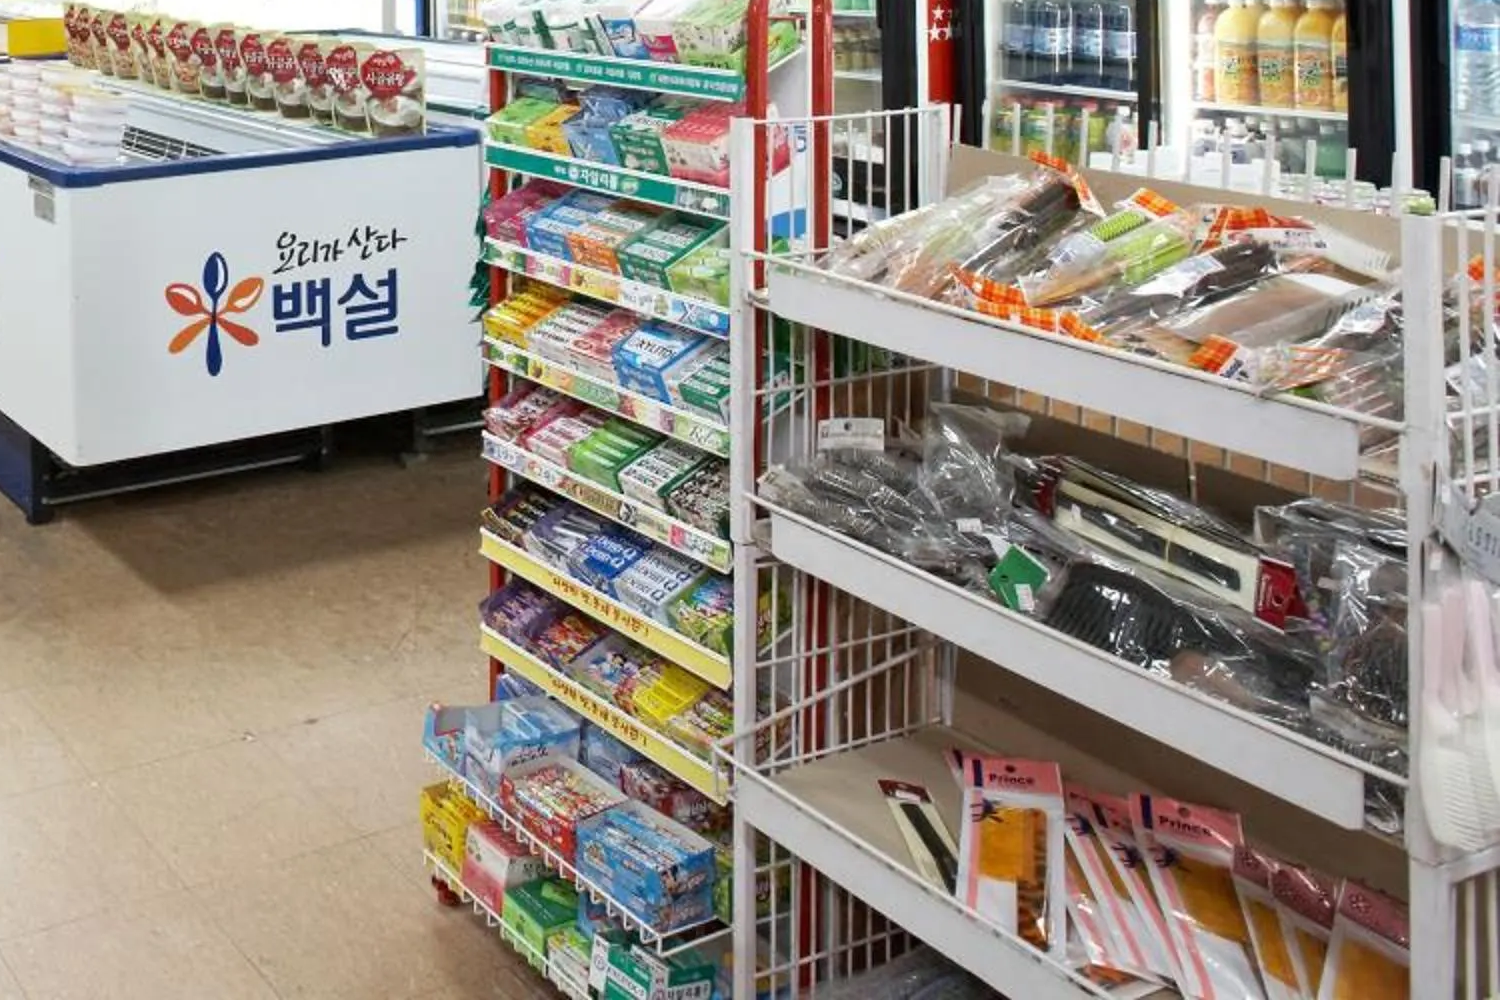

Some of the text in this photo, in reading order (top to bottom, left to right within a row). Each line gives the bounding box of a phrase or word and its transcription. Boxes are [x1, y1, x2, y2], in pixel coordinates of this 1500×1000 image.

[273, 224, 408, 275] 요리가 산다
[273, 268, 400, 348] 백설
[988, 772, 1035, 786] Prince
[1158, 814, 1212, 837] Prince
